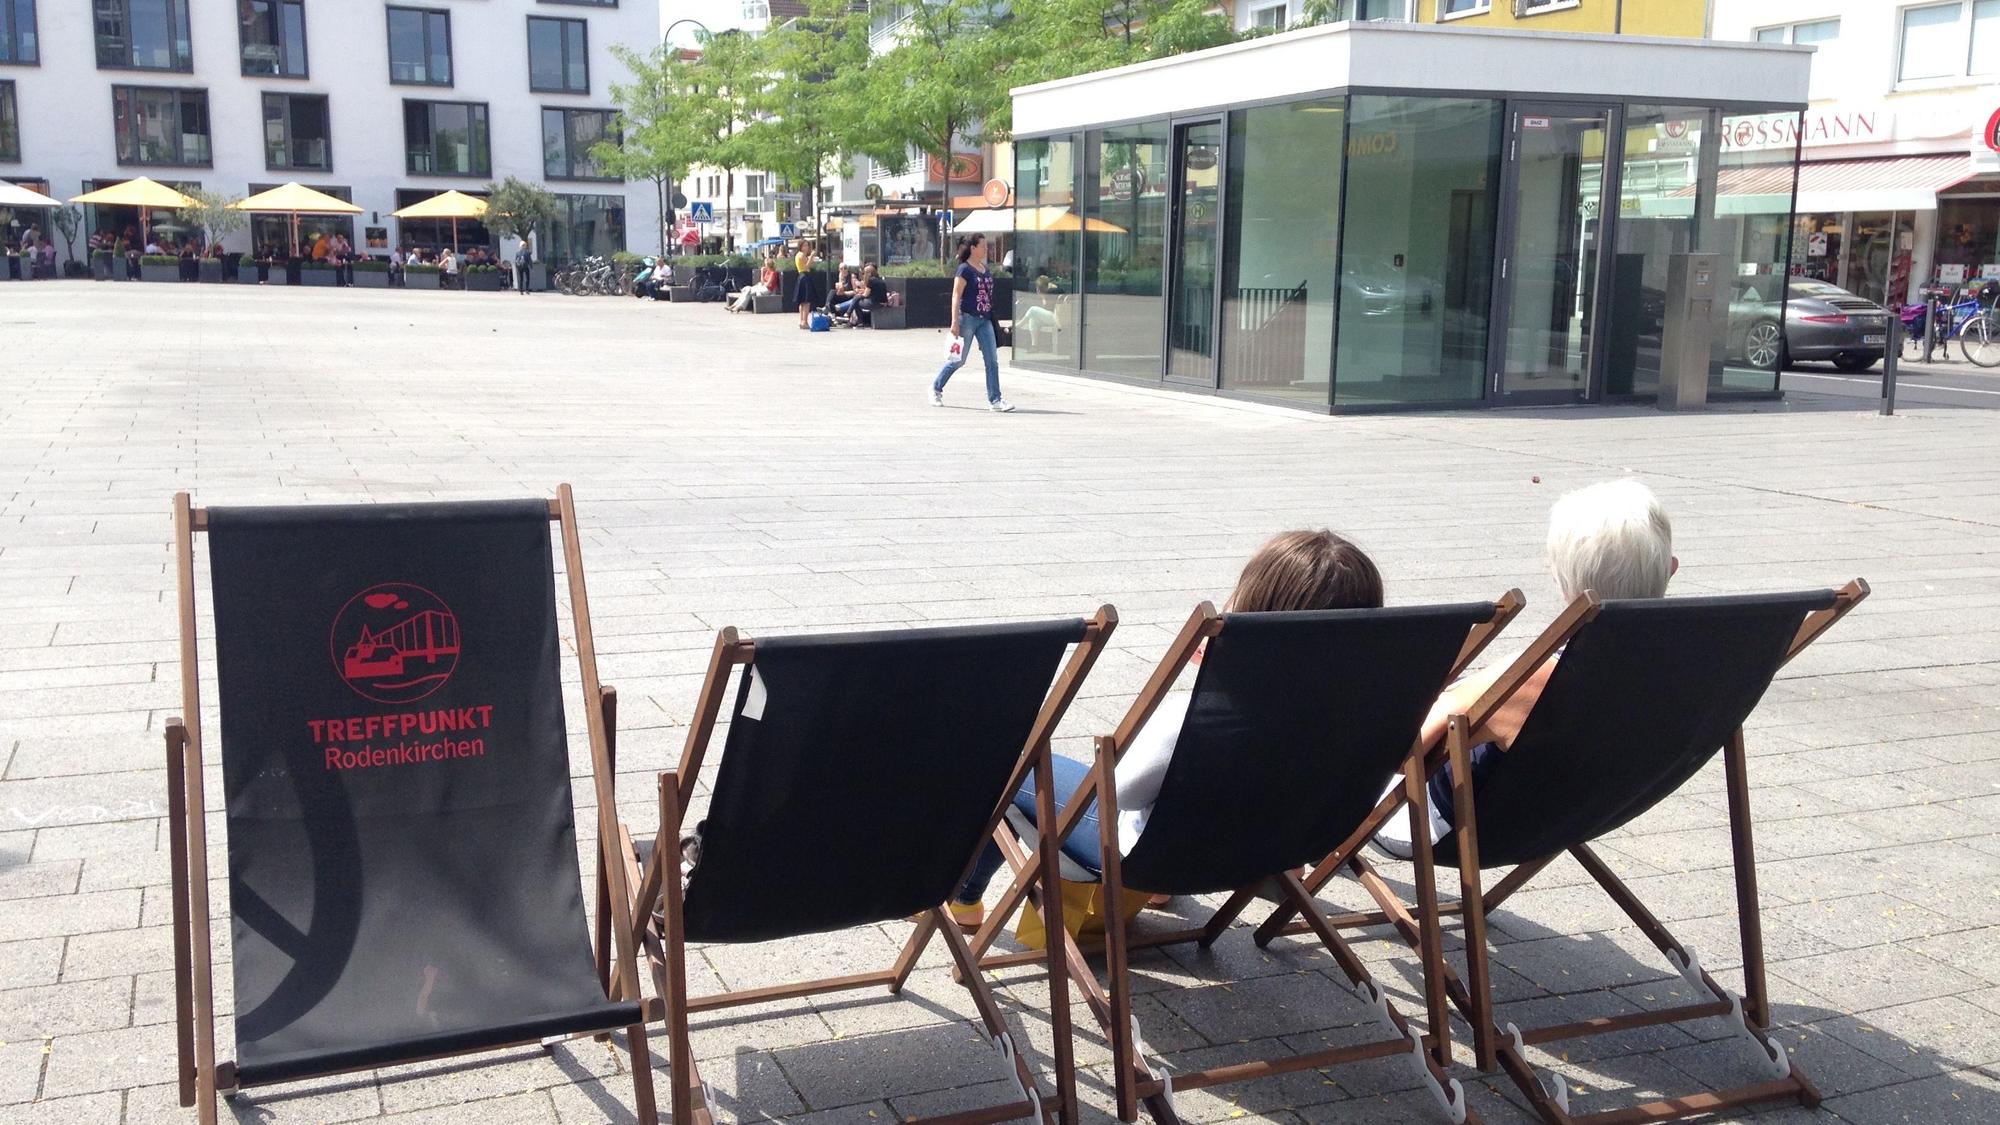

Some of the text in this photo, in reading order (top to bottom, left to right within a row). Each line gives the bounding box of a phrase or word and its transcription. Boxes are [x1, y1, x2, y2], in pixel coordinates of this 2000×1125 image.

[1720, 111, 1877, 148] ROSSMANN
[307, 705, 493, 744] TREFFPUNKT
[324, 738, 485, 770] Rodenkirchen
